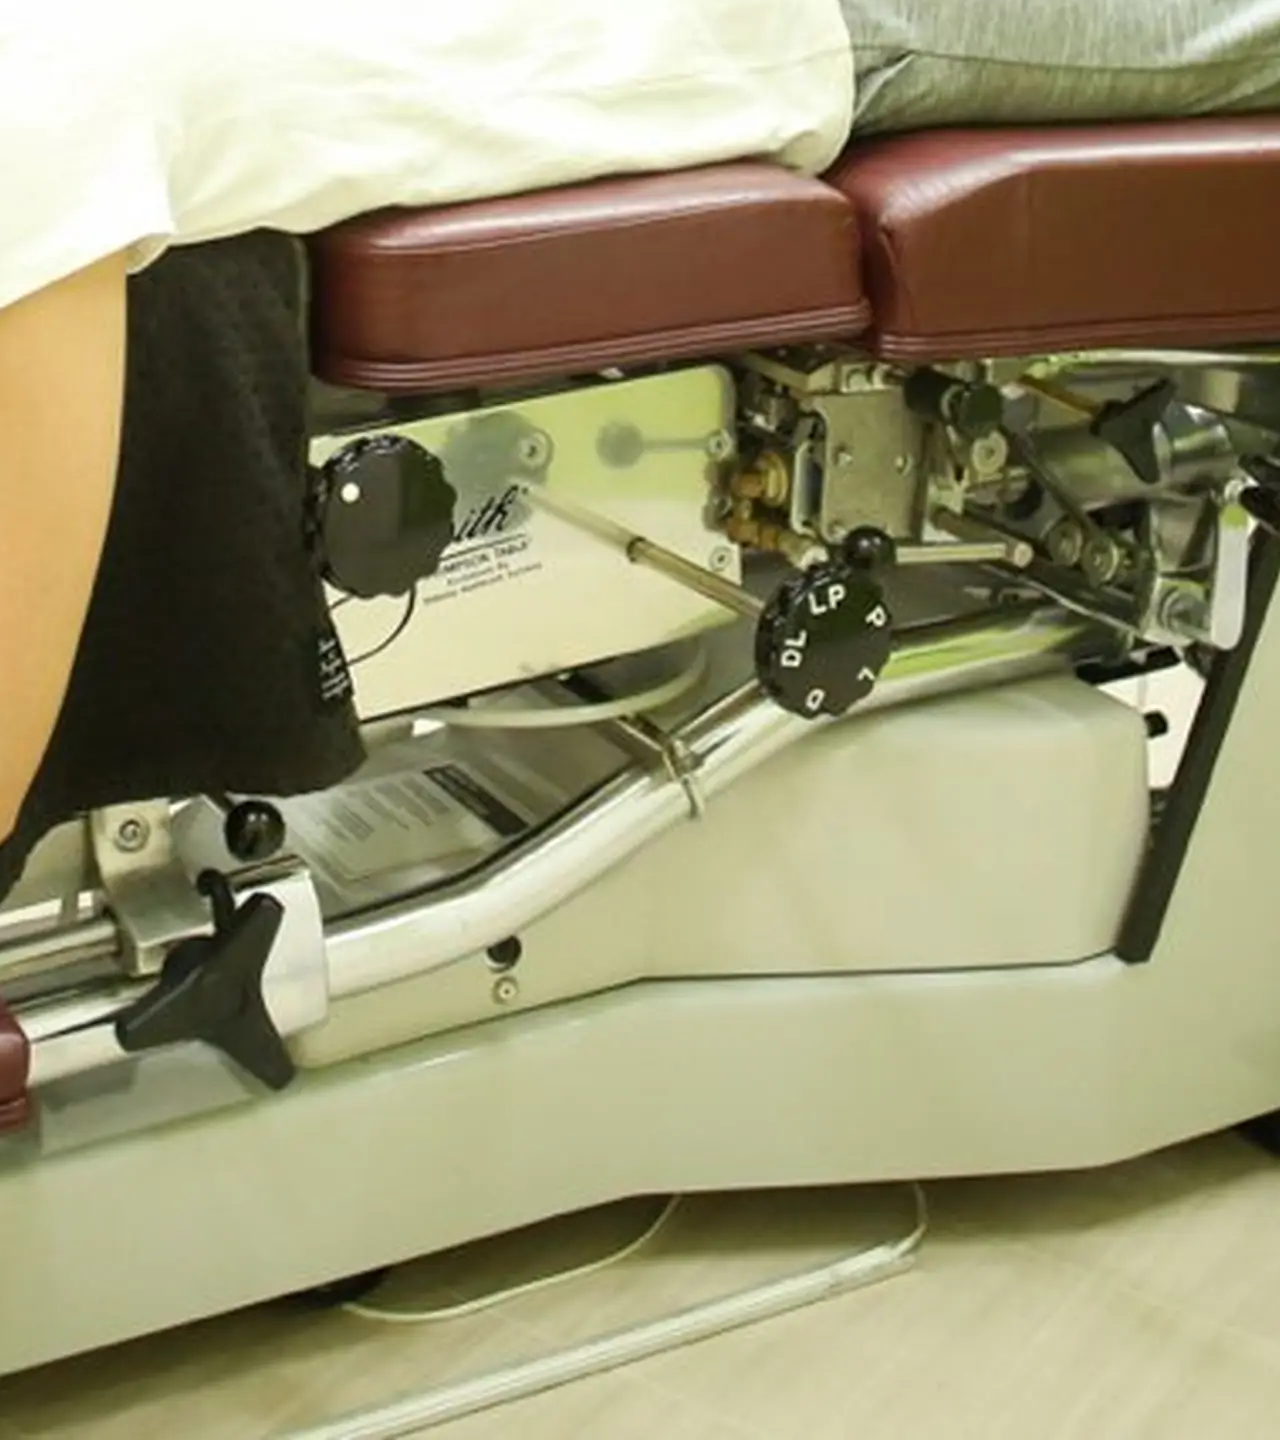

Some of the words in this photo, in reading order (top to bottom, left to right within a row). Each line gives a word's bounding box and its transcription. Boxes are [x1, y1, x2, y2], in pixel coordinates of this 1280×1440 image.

[807, 583, 846, 616] LP
[864, 604, 887, 627] P
[780, 629, 807, 667] DL
[856, 665, 876, 682] L
[805, 688, 825, 710] D
